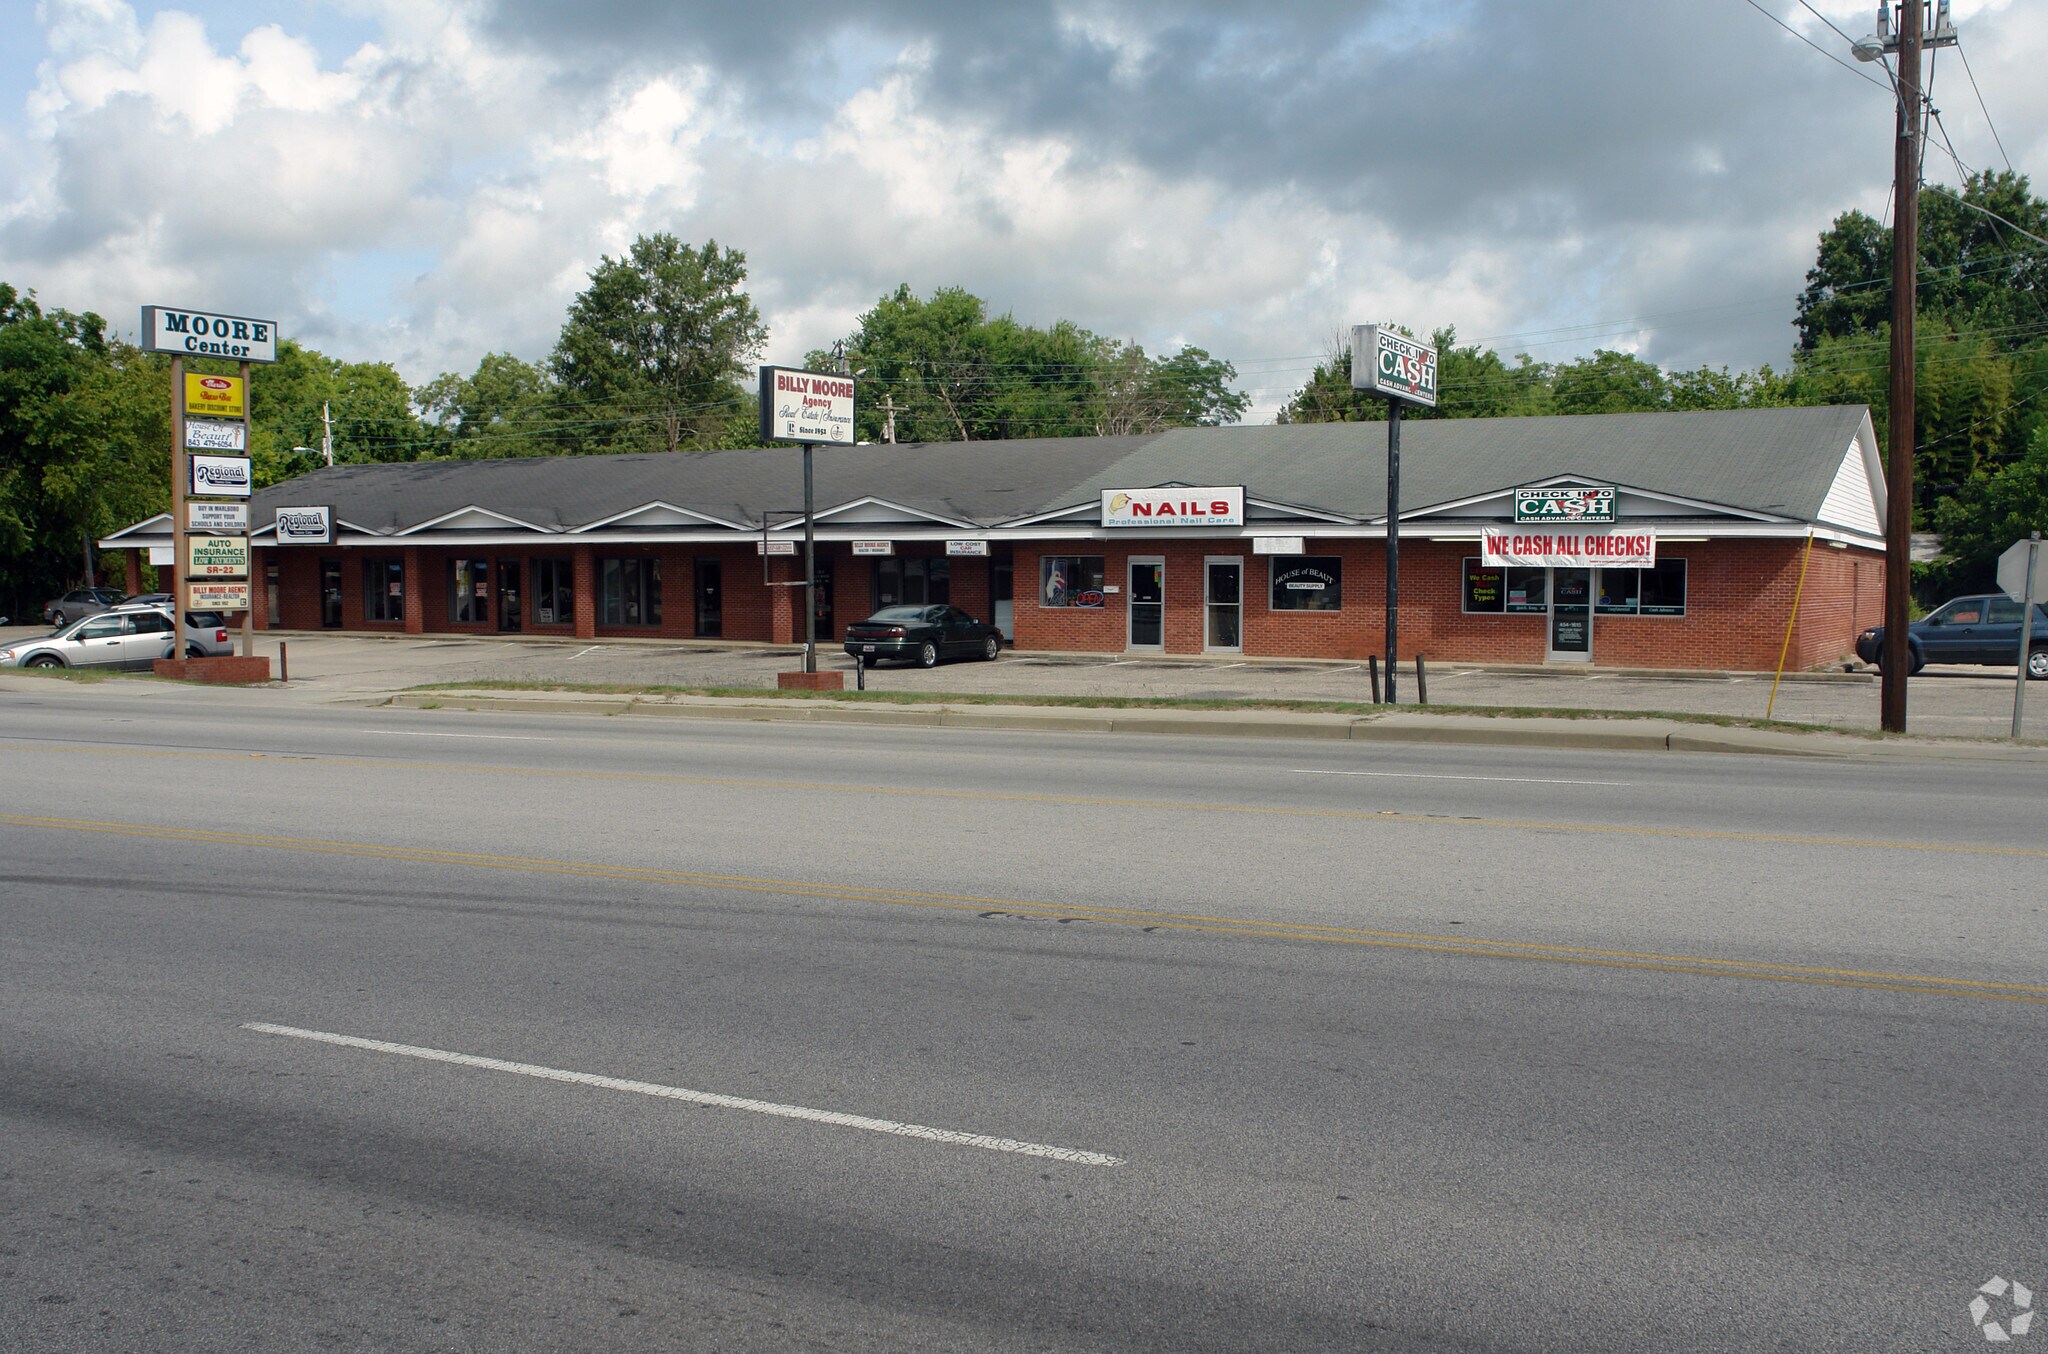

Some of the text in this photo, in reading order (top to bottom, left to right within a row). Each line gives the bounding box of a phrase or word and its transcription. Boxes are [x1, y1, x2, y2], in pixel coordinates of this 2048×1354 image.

[165, 312, 268, 342] MOORE
[185, 336, 250, 356] Center
[1380, 335, 1435, 365] CHECK IO
[778, 375, 853, 398] BILLY MOORE
[1379, 378, 1433, 400] CASH ADVANC CENTERS
[189, 402, 206, 410] BAKERY
[802, 395, 832, 410] Agency
[779, 404, 800, 418] Real
[188, 421, 211, 430] House
[799, 426, 814, 434] Since
[188, 438, 200, 446] 843
[197, 465, 246, 481] Regional
[1133, 501, 1229, 516] NAILS
[280, 513, 323, 531] Regional
[1108, 517, 1175, 525] Professional
[194, 548, 245, 556] INSURANCE
[1486, 535, 1651, 556] WE CASH ALL CHECKS!
[195, 557, 245, 565] LOW PAYMENTS
[206, 566, 234, 574] SR-22
[1275, 568, 1300, 585] HOUSE
[193, 586, 247, 594] BILLY MOORE AGENCY
[1076, 592, 1101, 604] OPEN
